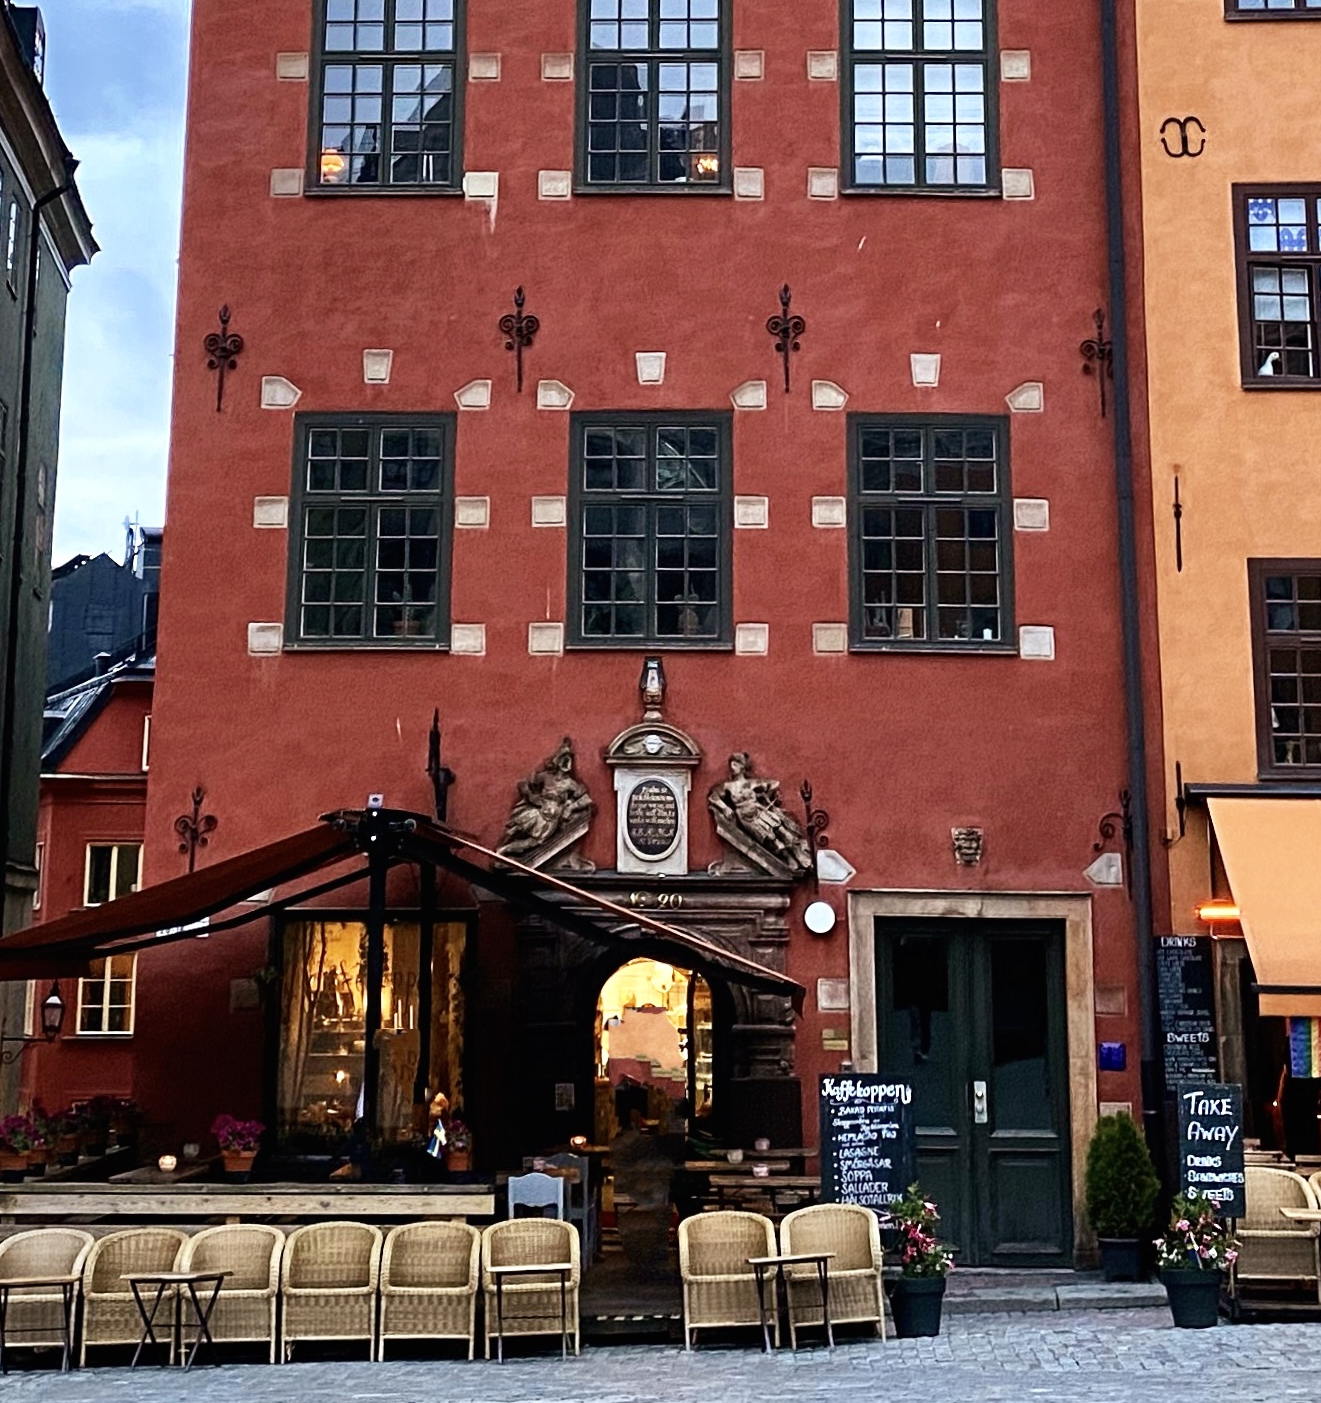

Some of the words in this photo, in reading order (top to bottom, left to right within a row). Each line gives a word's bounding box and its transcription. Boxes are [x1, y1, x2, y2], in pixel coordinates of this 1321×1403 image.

[1166, 1032, 1210, 1043] SWEETS
[821, 1078, 912, 1104] Kaffekoppen
[1183, 1091, 1233, 1115] TAKE
[1187, 1121, 1239, 1150] AWAY
